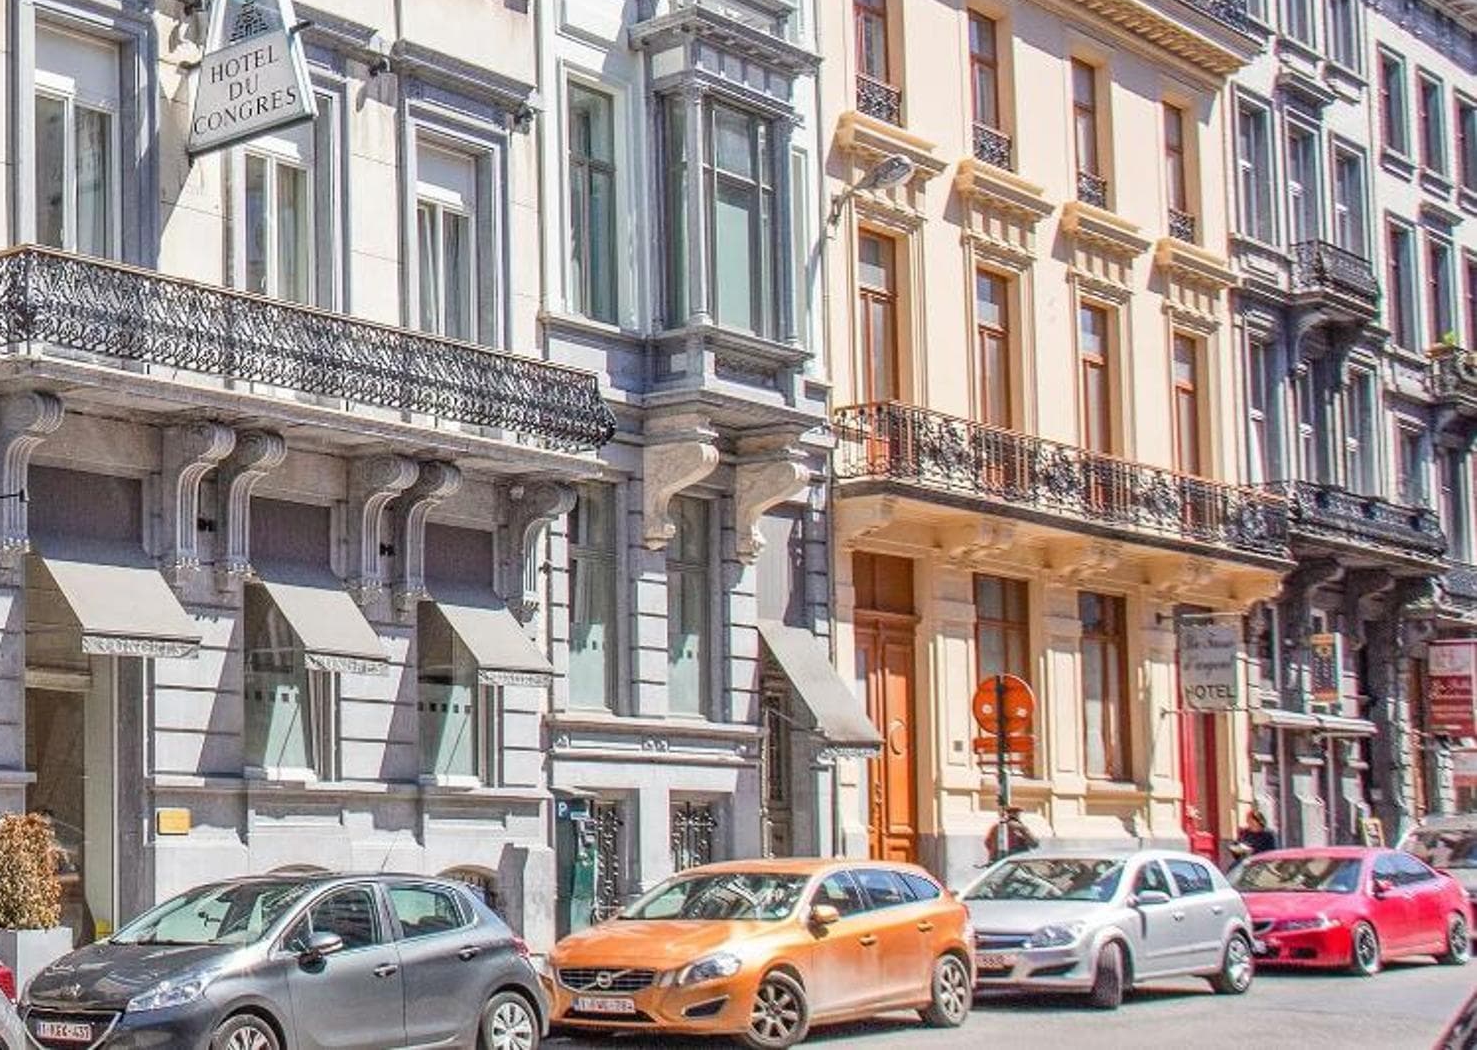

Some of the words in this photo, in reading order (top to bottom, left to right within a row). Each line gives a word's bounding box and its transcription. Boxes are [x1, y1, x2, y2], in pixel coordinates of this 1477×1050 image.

[210, 45, 279, 85] HOTEL
[228, 73, 260, 101] DU
[194, 86, 297, 135] CONGRES
